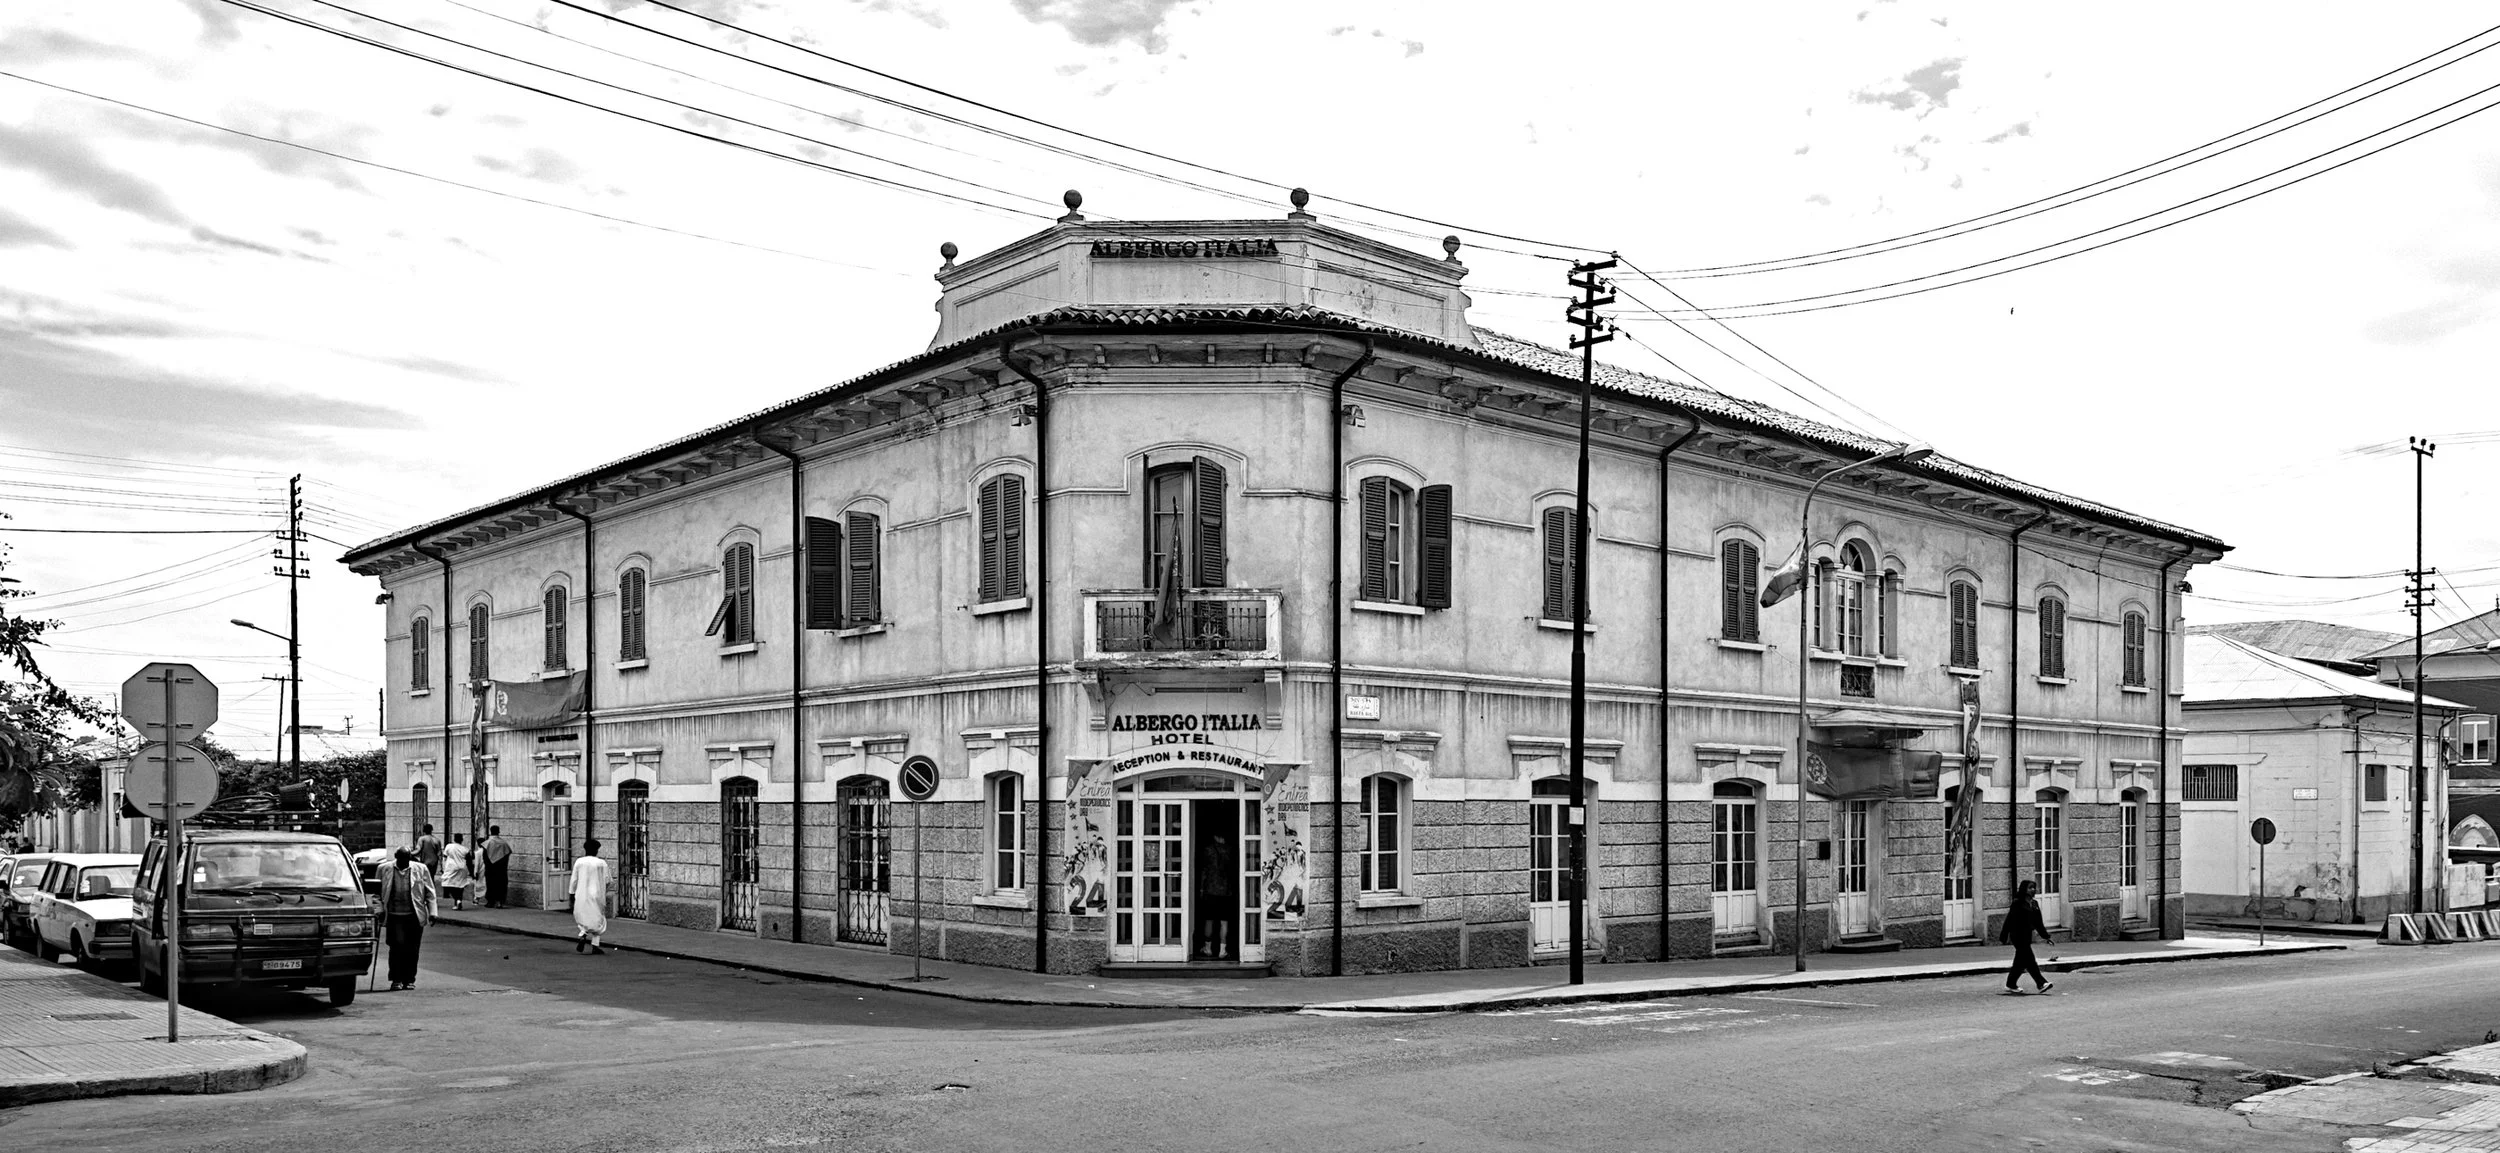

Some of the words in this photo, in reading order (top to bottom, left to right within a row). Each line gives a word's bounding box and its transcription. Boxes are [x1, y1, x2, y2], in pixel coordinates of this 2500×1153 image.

[1090, 239, 1198, 258] ALBERGO
[1204, 236, 1279, 257] ITALIA
[1112, 714, 1198, 731] ALBERGO
[1202, 714, 1261, 731] ITALIA
[1151, 733, 1214, 745] HOTEL
[1112, 751, 1170, 775] RECEPTION
[1177, 751, 1185, 760] &
[1190, 751, 1265, 775] RESTAURANT
[1069, 875, 1107, 915] 24
[1266, 880, 1305, 919] 24
